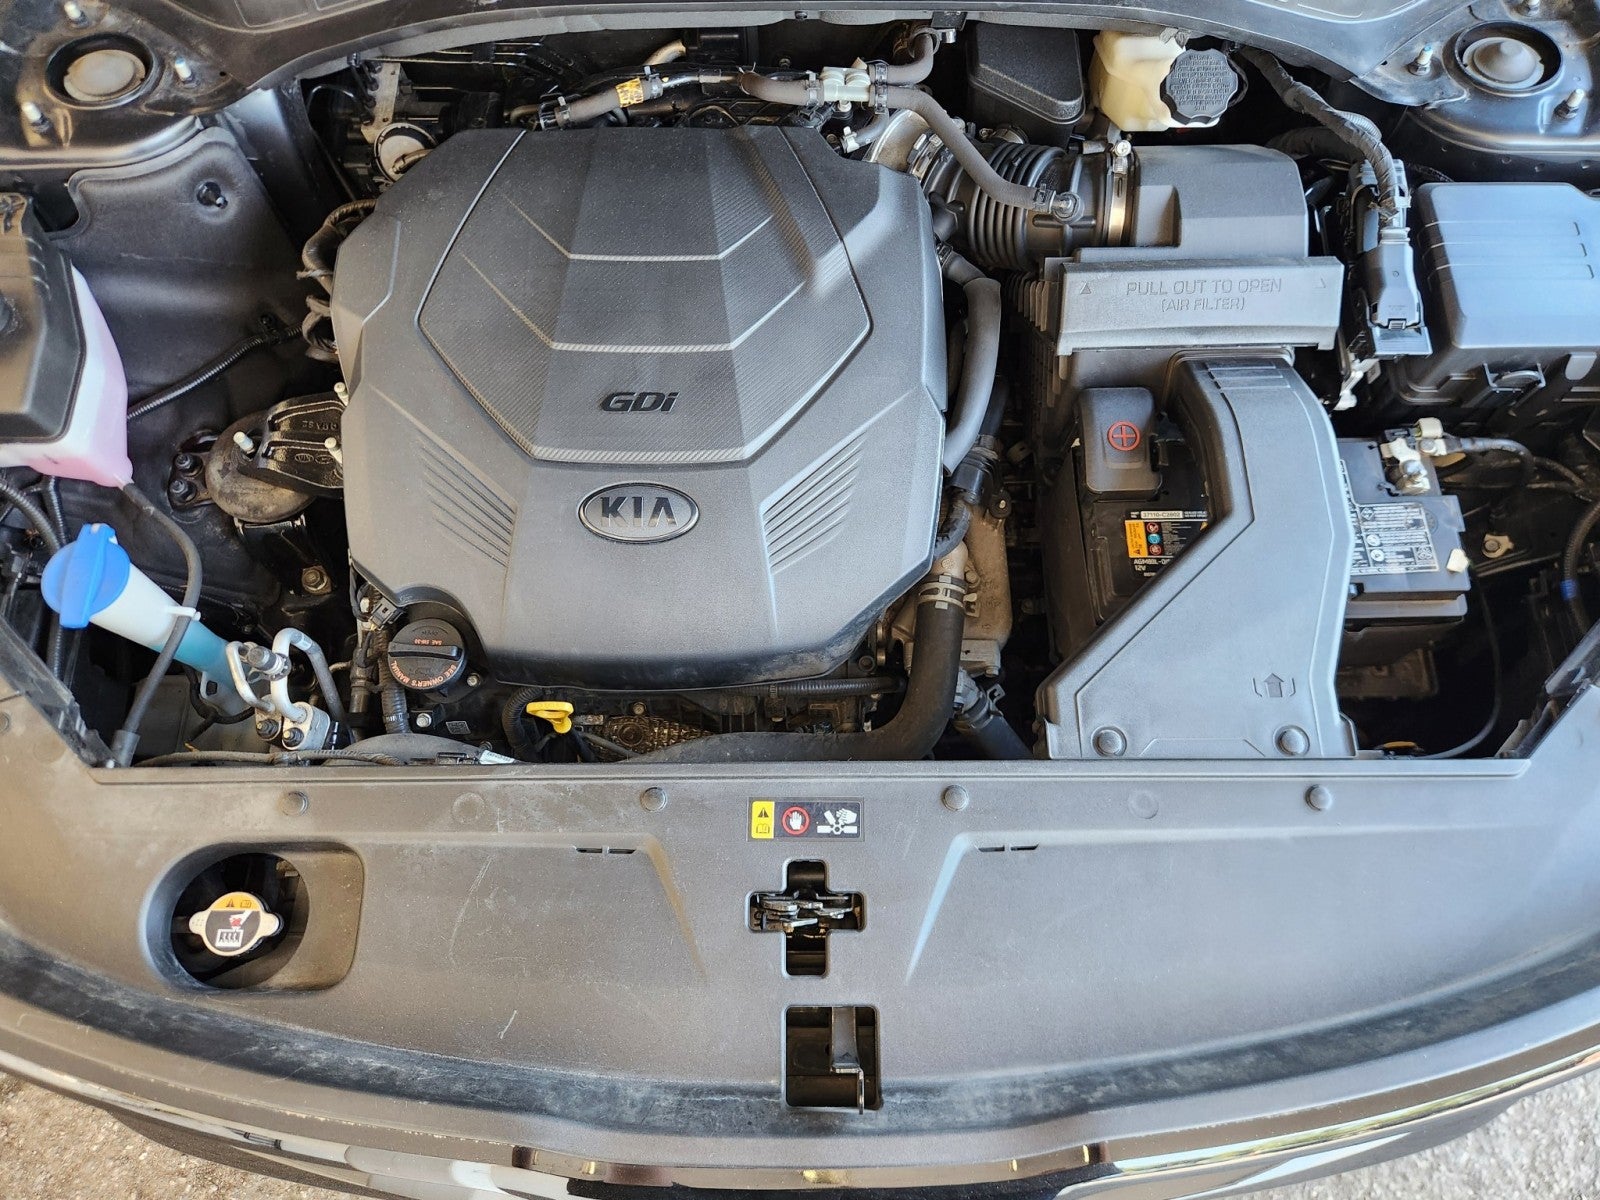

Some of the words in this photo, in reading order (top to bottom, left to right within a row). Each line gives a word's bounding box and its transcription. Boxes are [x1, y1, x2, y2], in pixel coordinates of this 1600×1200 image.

[1126, 280, 1168, 295] PULL
[1173, 280, 1207, 295] OUT
[1211, 279, 1233, 294] TO
[1238, 278, 1282, 293] OPEN
[1161, 298, 1190, 312] (AIR
[1194, 297, 1245, 311] FILTER)
[600, 392, 680, 412] GDi
[600, 496, 678, 527] KIA
[391, 660, 411, 683] MANUAL
[444, 664, 457, 678] SEE
[411, 676, 444, 687] OWNER'S
